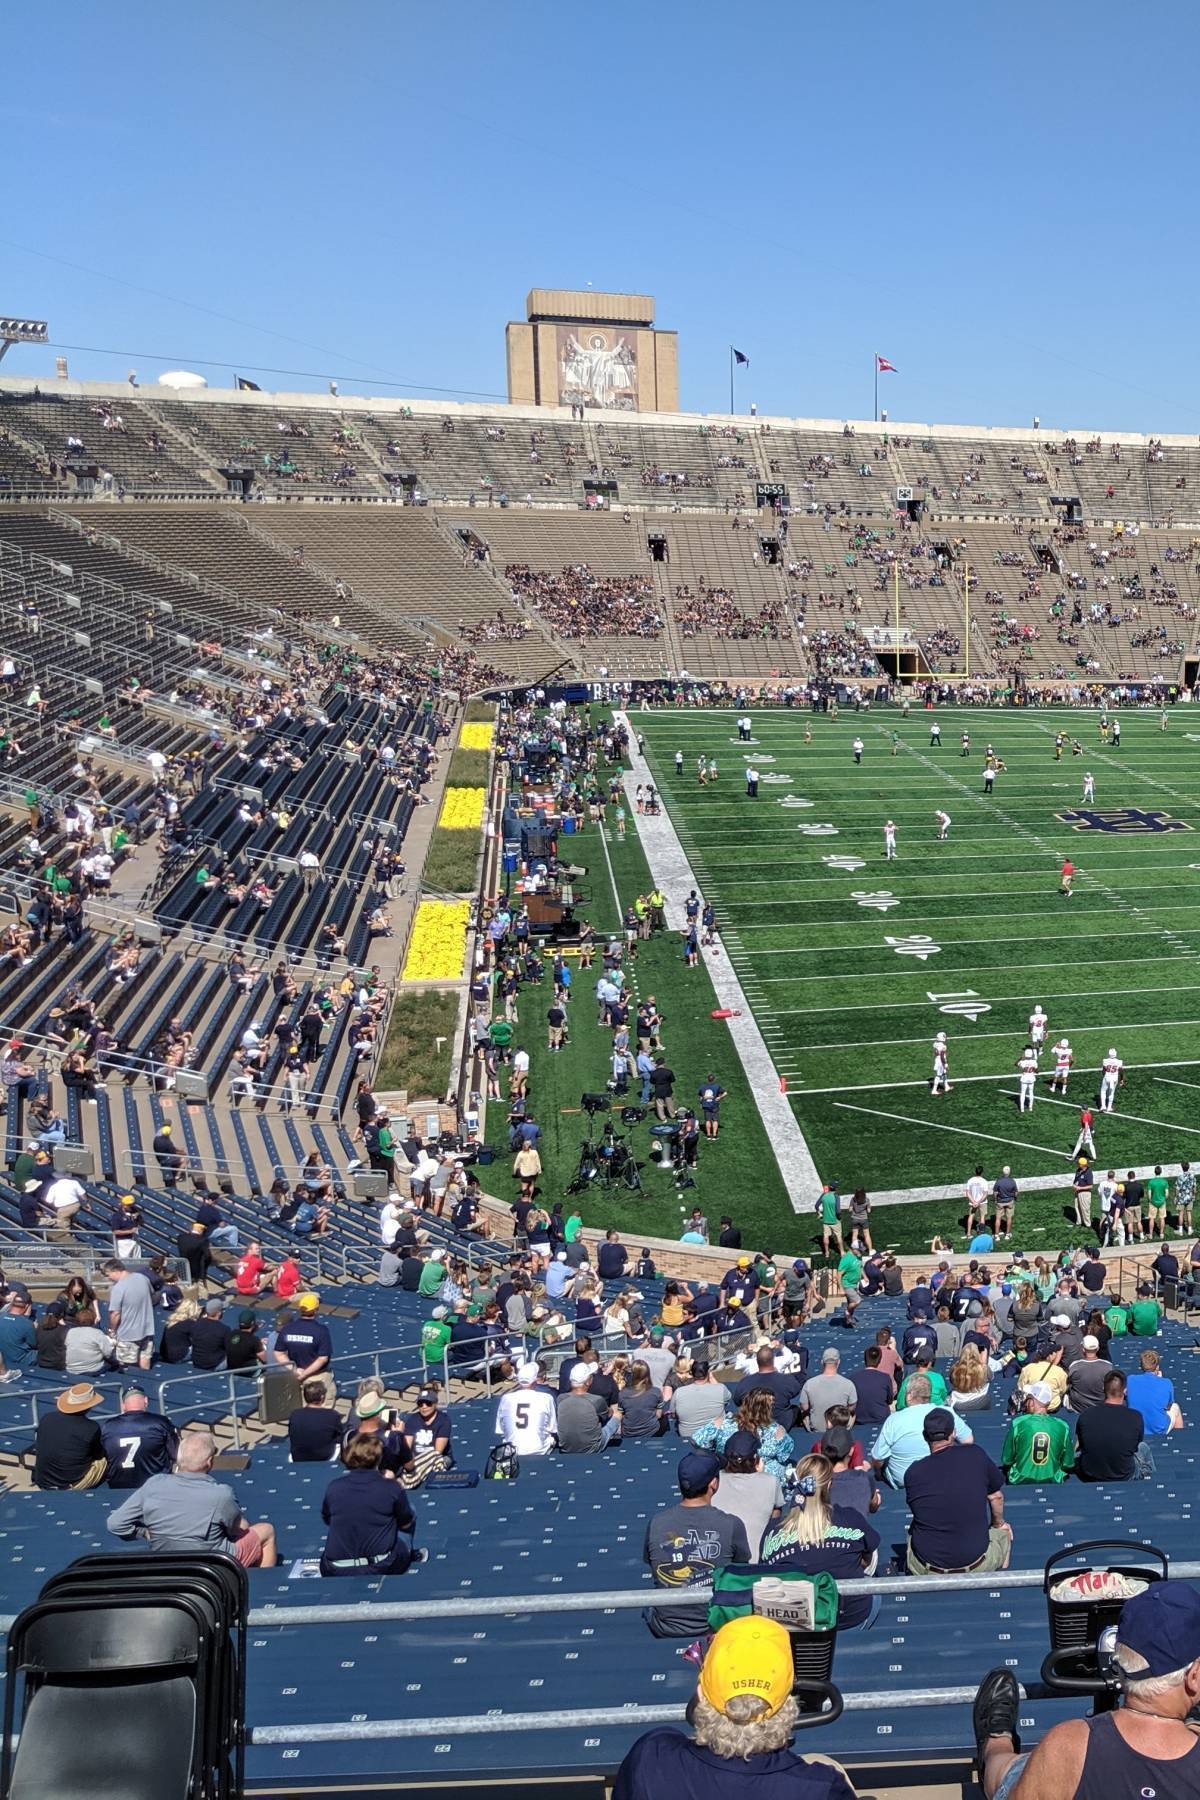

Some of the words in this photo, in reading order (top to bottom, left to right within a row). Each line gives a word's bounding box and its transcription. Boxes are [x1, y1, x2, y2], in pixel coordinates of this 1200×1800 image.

[850, 890, 901, 906] 30
[883, 934, 942, 954] 20
[926, 988, 992, 1014] 10
[959, 1299, 969, 1315] 7
[286, 1333, 314, 1344] USHER
[913, 1337, 927, 1359] 7
[515, 1403, 530, 1429] 5
[119, 1436, 141, 1469] 7
[671, 1552, 684, 1563] 19
[766, 1607, 799, 1619] HEAD
[732, 1678, 771, 1691] USHER
